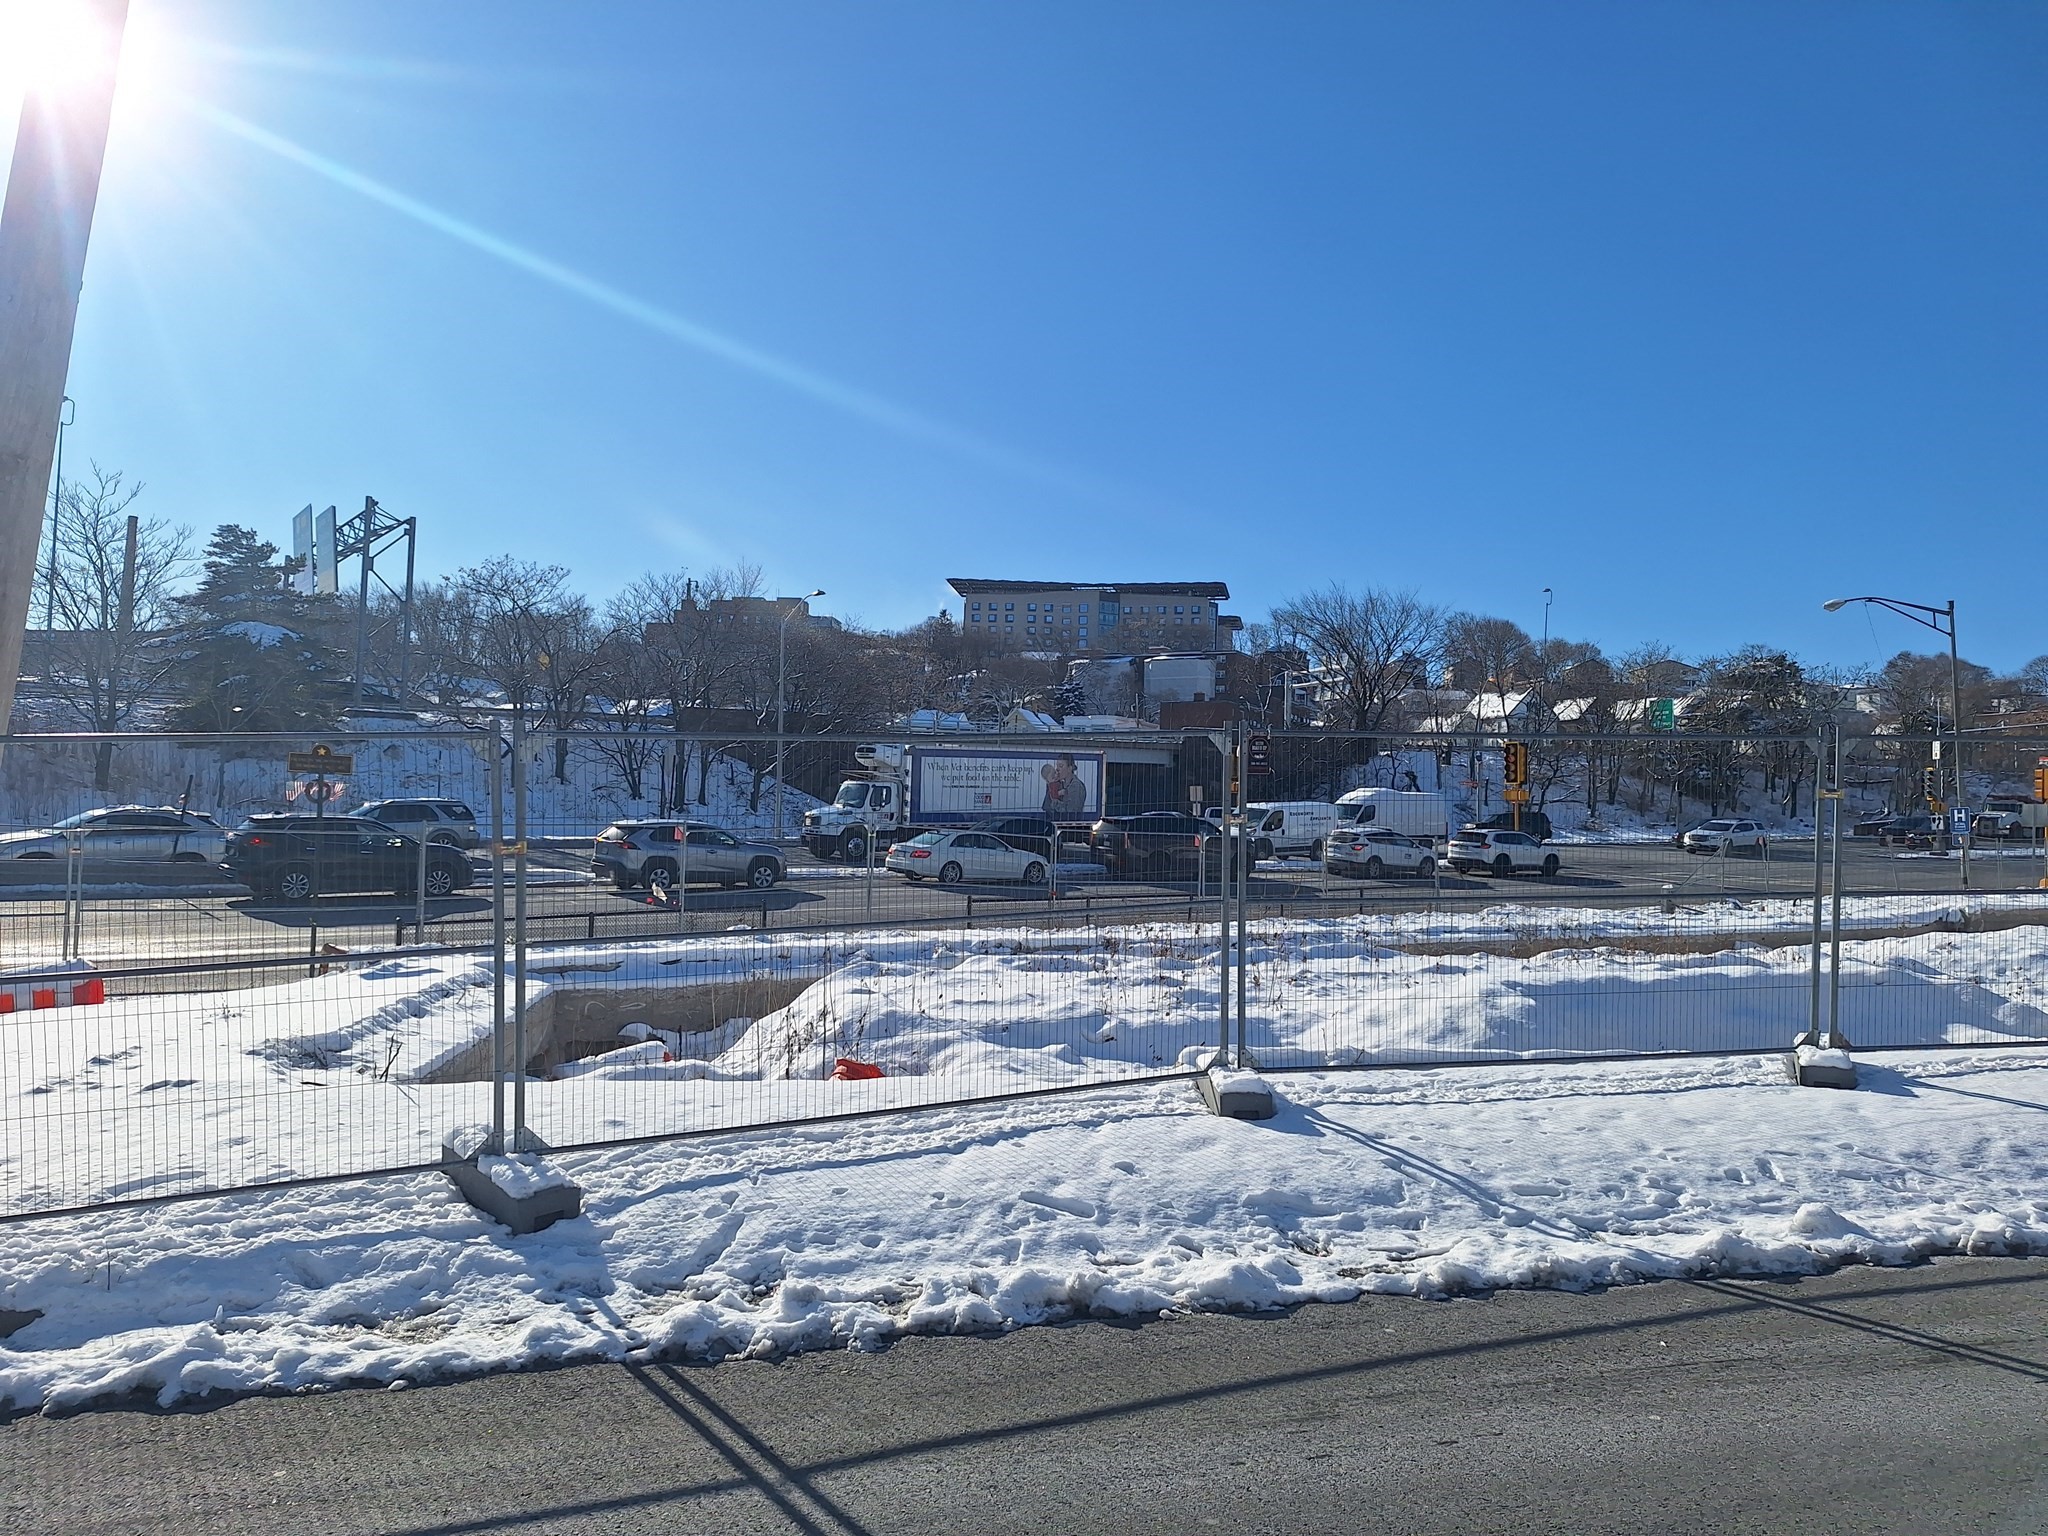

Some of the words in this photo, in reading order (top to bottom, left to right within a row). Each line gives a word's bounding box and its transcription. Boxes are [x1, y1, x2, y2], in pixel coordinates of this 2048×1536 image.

[927, 762, 949, 771] When
[951, 763, 962, 771] Vet
[964, 763, 990, 772] benefits
[1007, 763, 1022, 774] keep
[952, 774, 964, 783] put
[965, 773, 981, 781] food
[992, 773, 1002, 781] the
[1954, 809, 1966, 822] H
